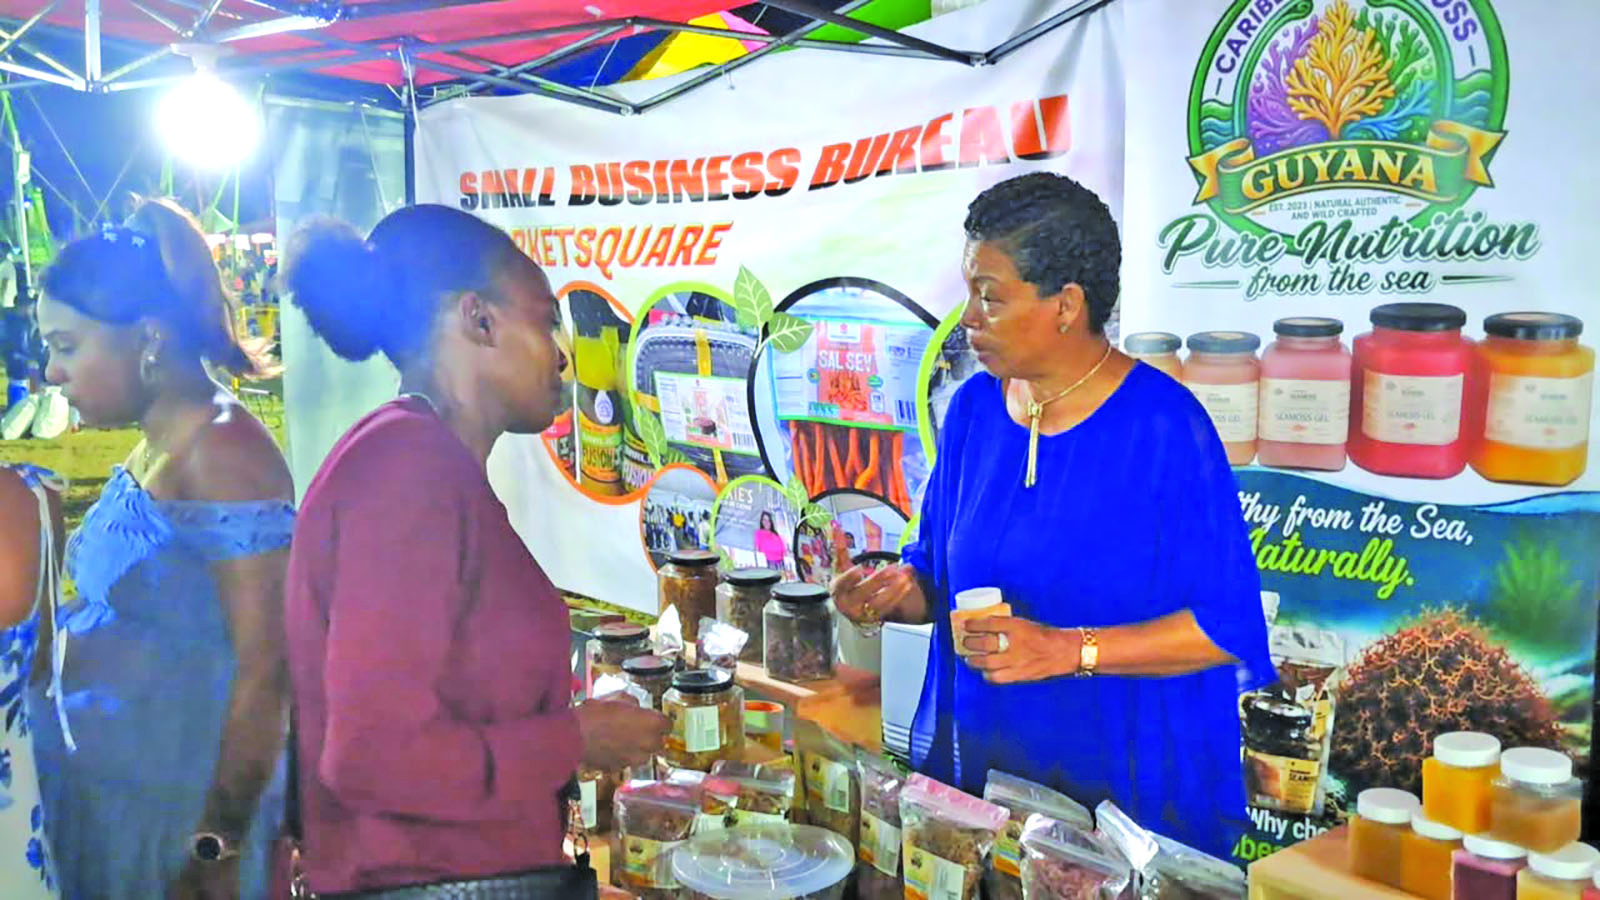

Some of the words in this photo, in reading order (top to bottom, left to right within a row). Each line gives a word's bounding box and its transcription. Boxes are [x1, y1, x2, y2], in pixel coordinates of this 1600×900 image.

[1215, 0, 1284, 73] CARIB
[459, 166, 556, 211] SMALL
[567, 148, 801, 207] BUSINESS
[808, 94, 1072, 191] BUREAU
[1241, 147, 1438, 200] GUYANA
[1291, 211, 1310, 220] AND
[1312, 210, 1335, 219] WILD
[1337, 208, 1378, 218] CRAFTED
[1313, 199, 1352, 210] NATURAL
[1354, 196, 1401, 207] AUTHENTIC
[1158, 213, 1286, 271] Pure
[1297, 211, 1538, 265] Nutrition
[1246, 263, 1320, 299] from
[1328, 263, 1373, 292] the
[1380, 269, 1433, 292] sea
[818, 350, 844, 370] SAL
[1282, 495, 1354, 537] from
[1359, 501, 1404, 534] the
[1409, 504, 1474, 545] Sea,
[1245, 806, 1289, 841] Why
